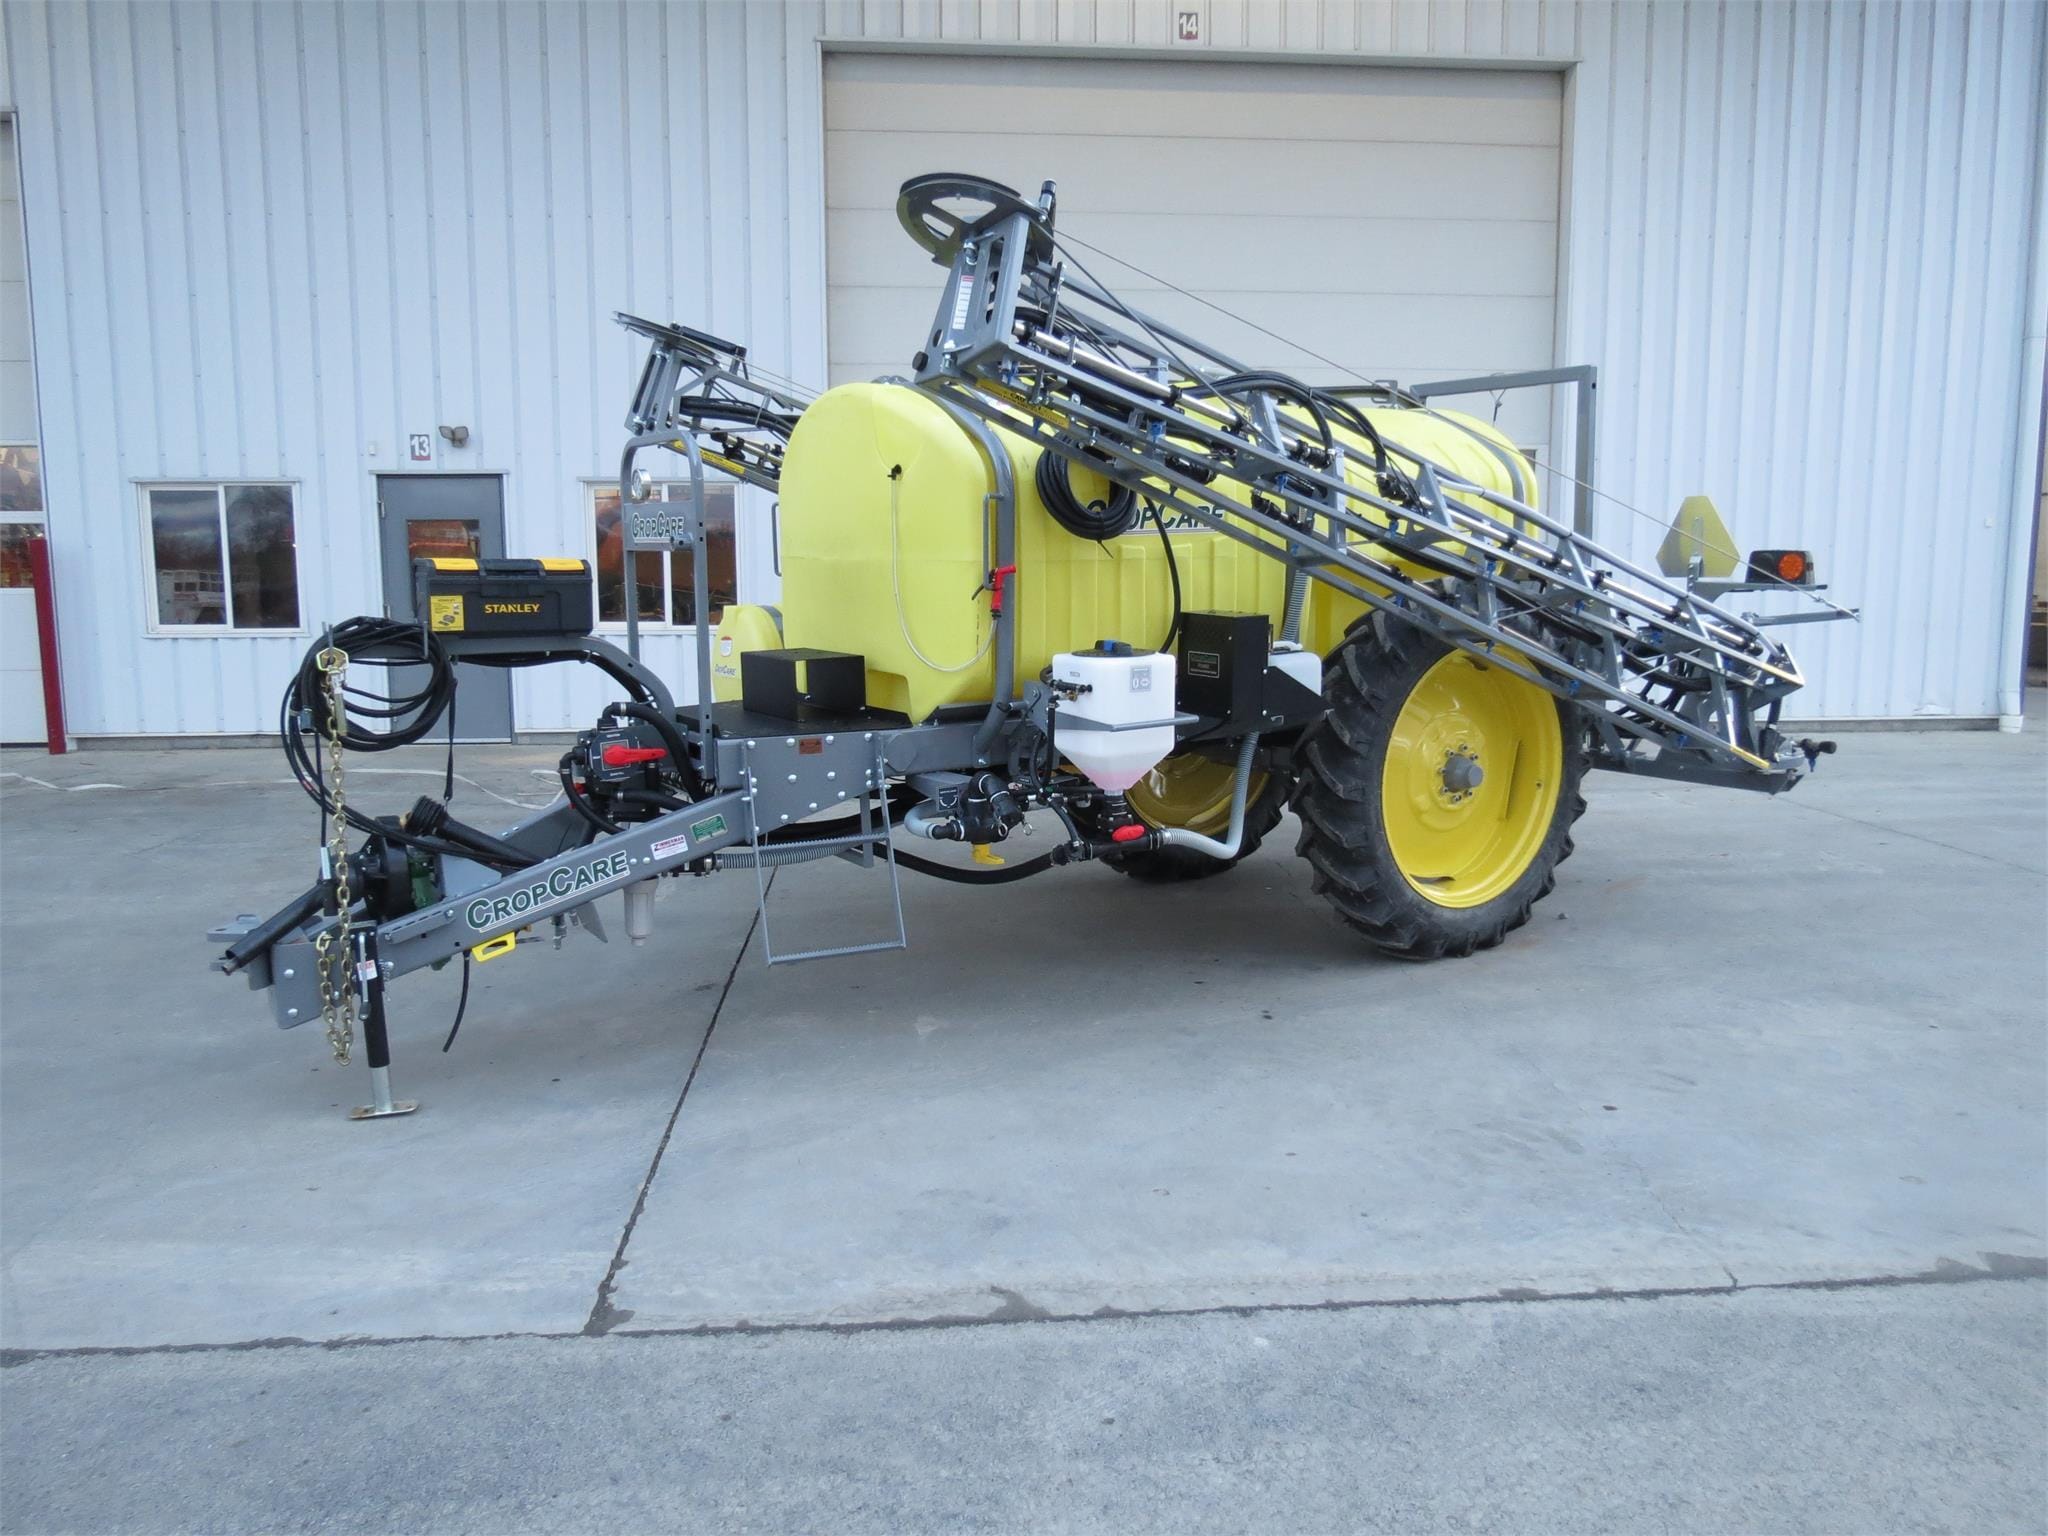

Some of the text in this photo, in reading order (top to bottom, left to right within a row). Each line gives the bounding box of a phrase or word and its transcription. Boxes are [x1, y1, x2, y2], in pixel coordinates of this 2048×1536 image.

[1180, 14, 1198, 36] 14
[411, 435, 430, 457] 13
[484, 603, 540, 614] STANLEY
[466, 850, 629, 931] CROPCARE
